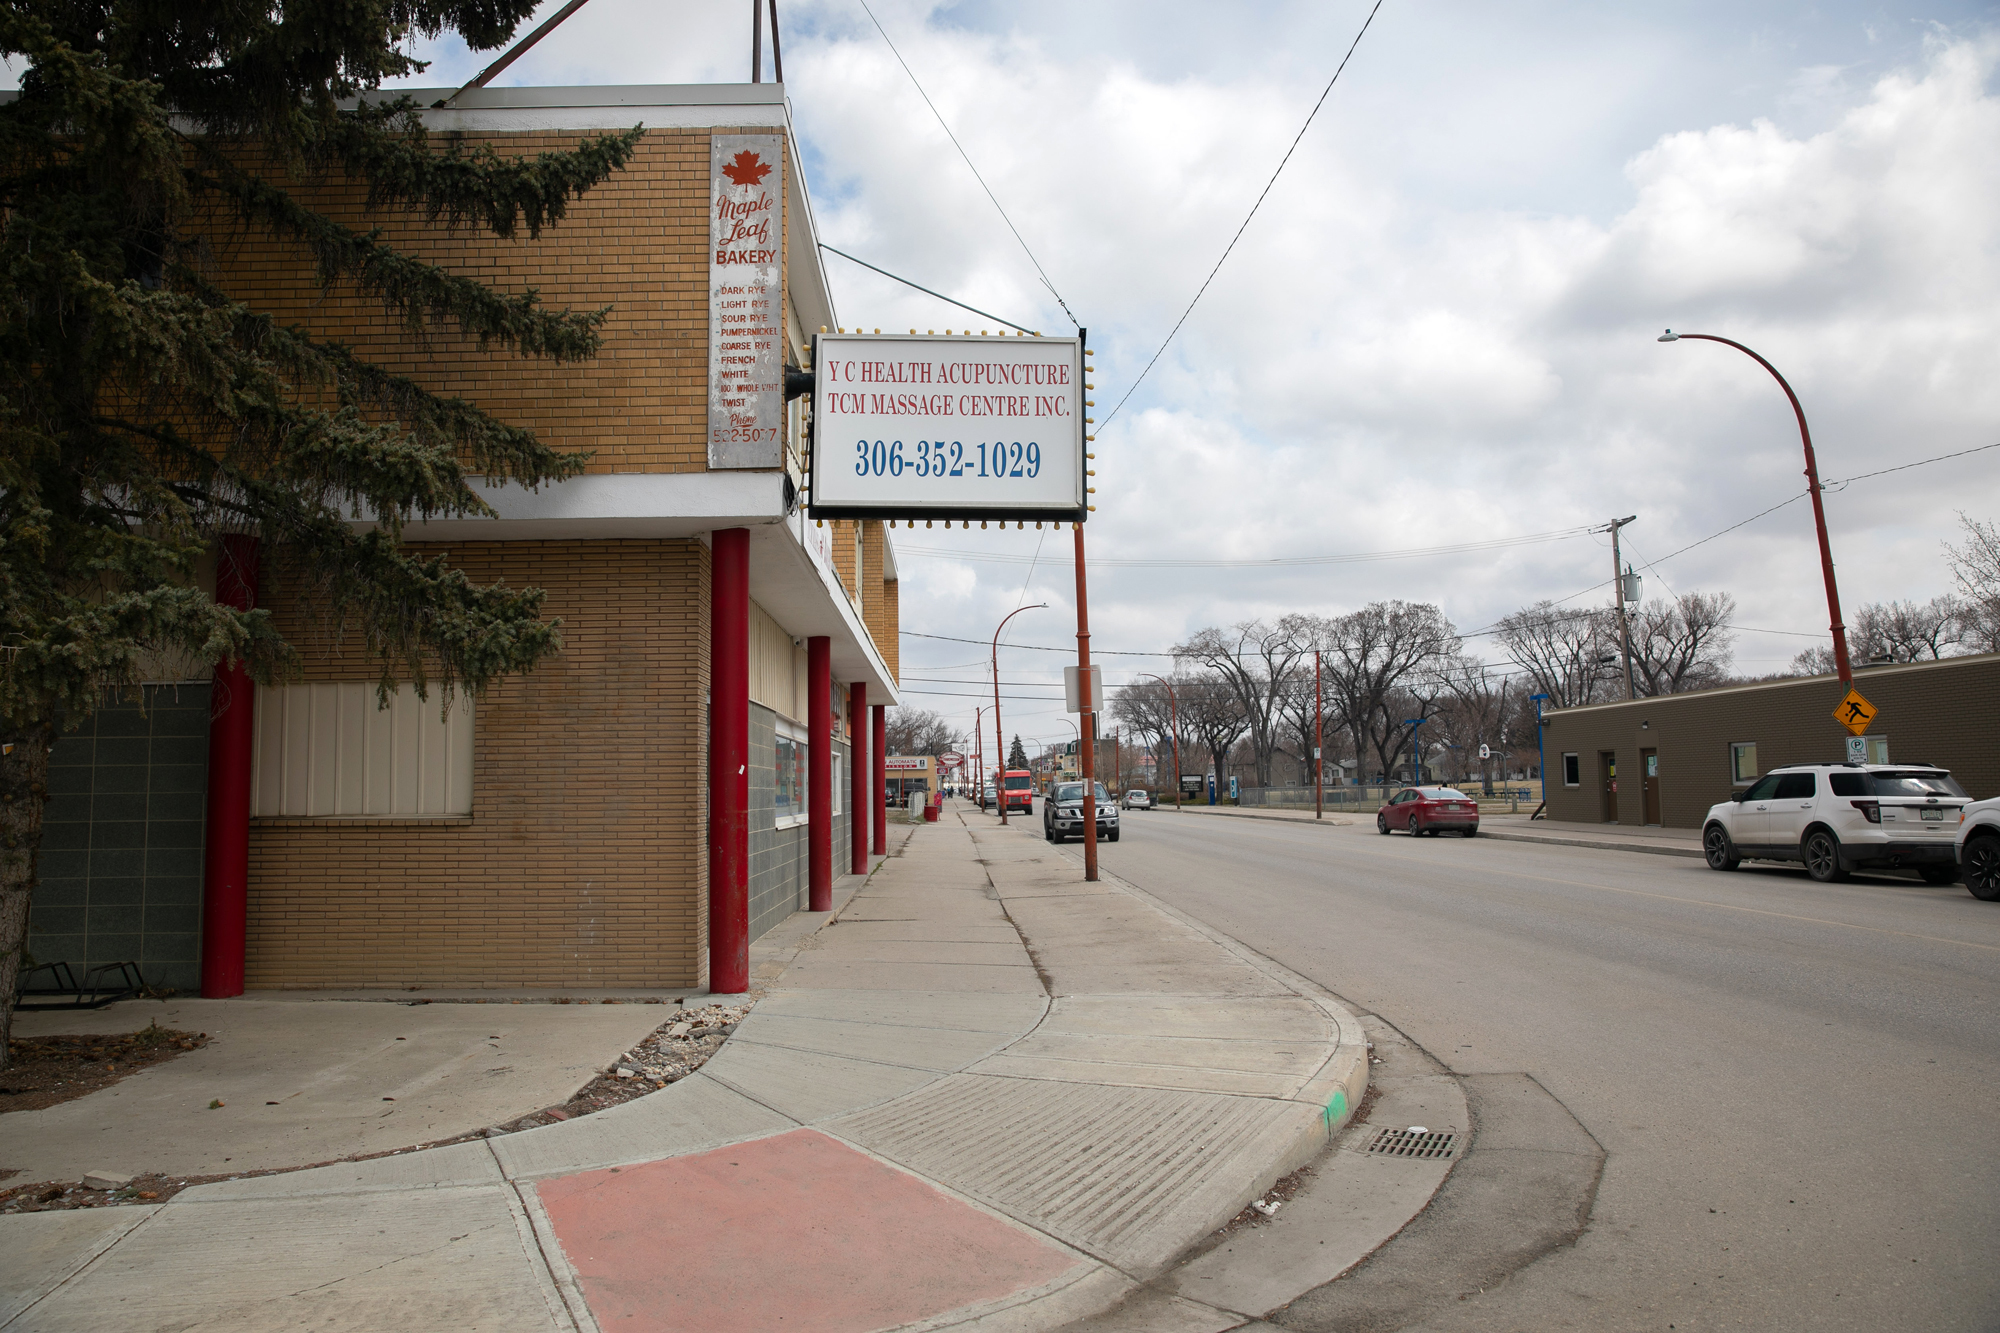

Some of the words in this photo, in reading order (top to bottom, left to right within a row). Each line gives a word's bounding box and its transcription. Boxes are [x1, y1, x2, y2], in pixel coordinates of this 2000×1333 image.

[717, 192, 773, 220] Maple
[719, 218, 769, 246] Leaf
[716, 250, 776, 265] BAKERY
[721, 286, 745, 295] DARK
[748, 286, 766, 294] RYE
[721, 300, 747, 309] LIGHT
[751, 300, 770, 308] RYE
[721, 314, 746, 323] SOUR
[750, 313, 768, 322] RYE
[721, 327, 778, 337] PUMPERNICKEL
[721, 342, 751, 351] COARSE
[755, 341, 771, 350] RYE
[721, 355, 756, 365] FRENCH
[722, 370, 749, 379] WHITE
[828, 360, 839, 382] Y
[845, 361, 856, 383] C
[861, 361, 932, 384] HEALTH
[936, 363, 1070, 385] ACUPUNCTURE
[737, 383, 759, 393] WHOLE
[762, 383, 779, 392] WHT.
[722, 399, 745, 407] TWIST
[828, 392, 866, 414] TCM
[871, 393, 954, 416] MASSAGE
[959, 394, 1030, 417] CENTRE
[1035, 395, 1070, 417] INC.
[730, 413, 757, 428] Phone
[855, 439, 1041, 478] 306-352-1029
[1854, 741, 1861, 749] P
